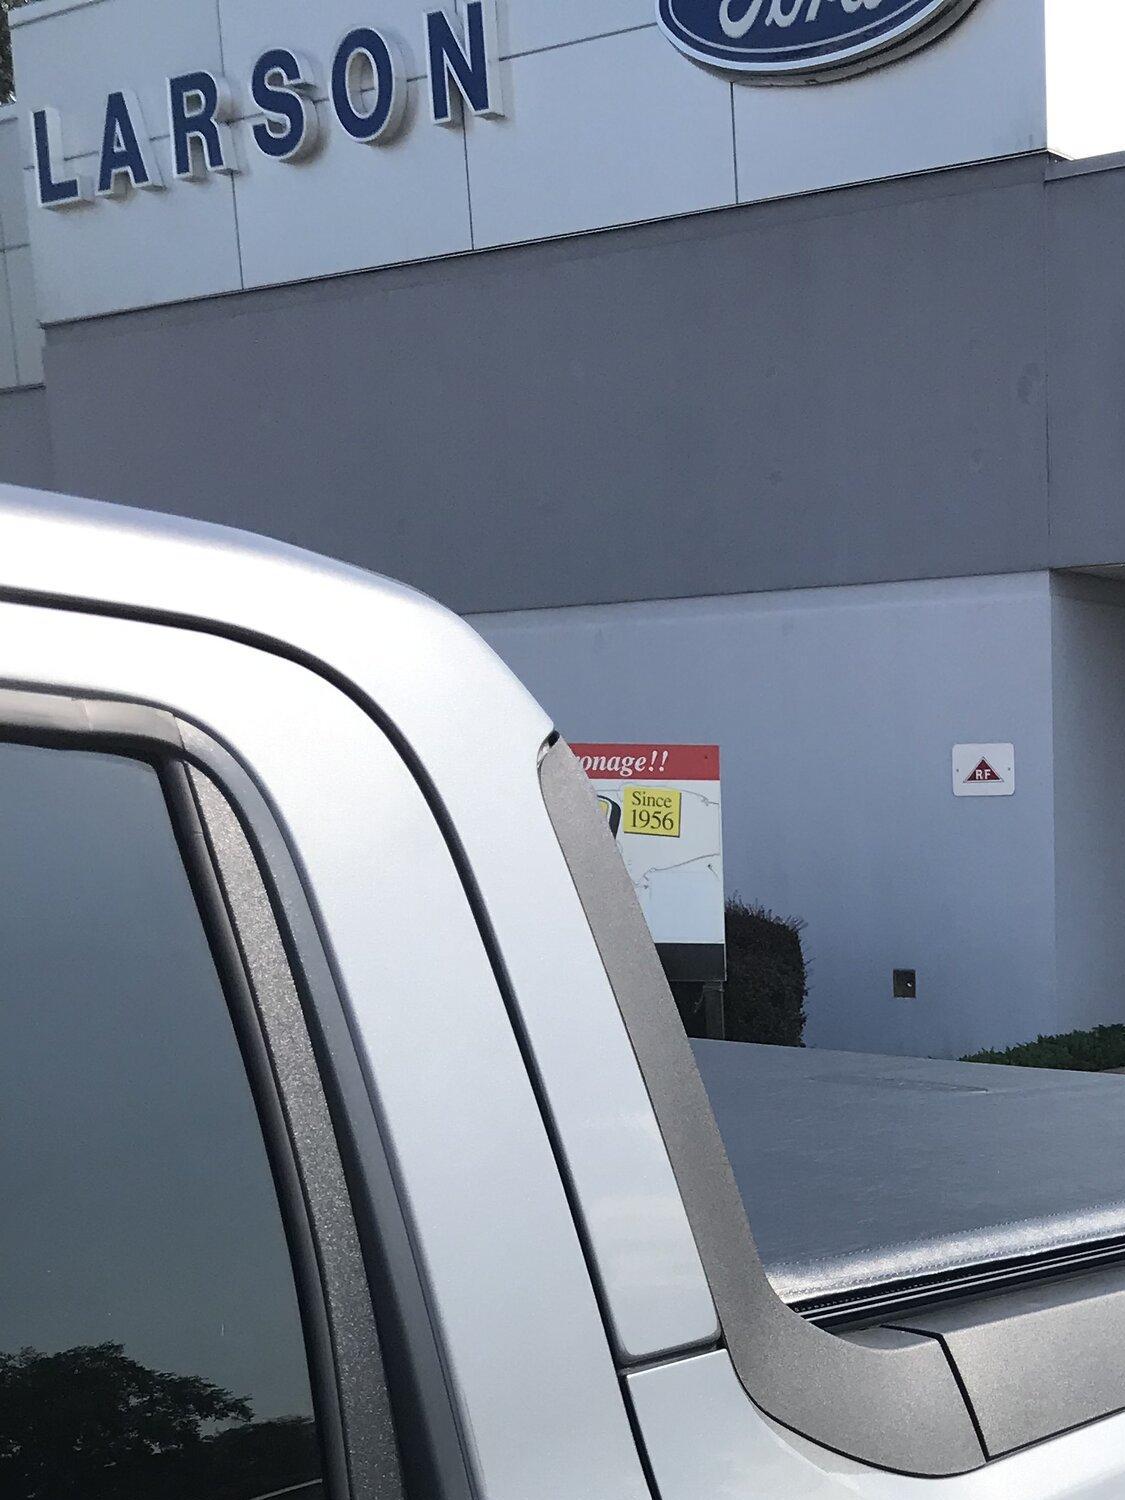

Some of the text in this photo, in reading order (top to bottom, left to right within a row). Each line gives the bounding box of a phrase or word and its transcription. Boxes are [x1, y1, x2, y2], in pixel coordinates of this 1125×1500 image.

[29, 0, 500, 210] LARSON
[577, 750, 669, 777] onage!!
[975, 769, 991, 780] RF
[631, 790, 673, 808] Since
[631, 809, 675, 831] 1956
